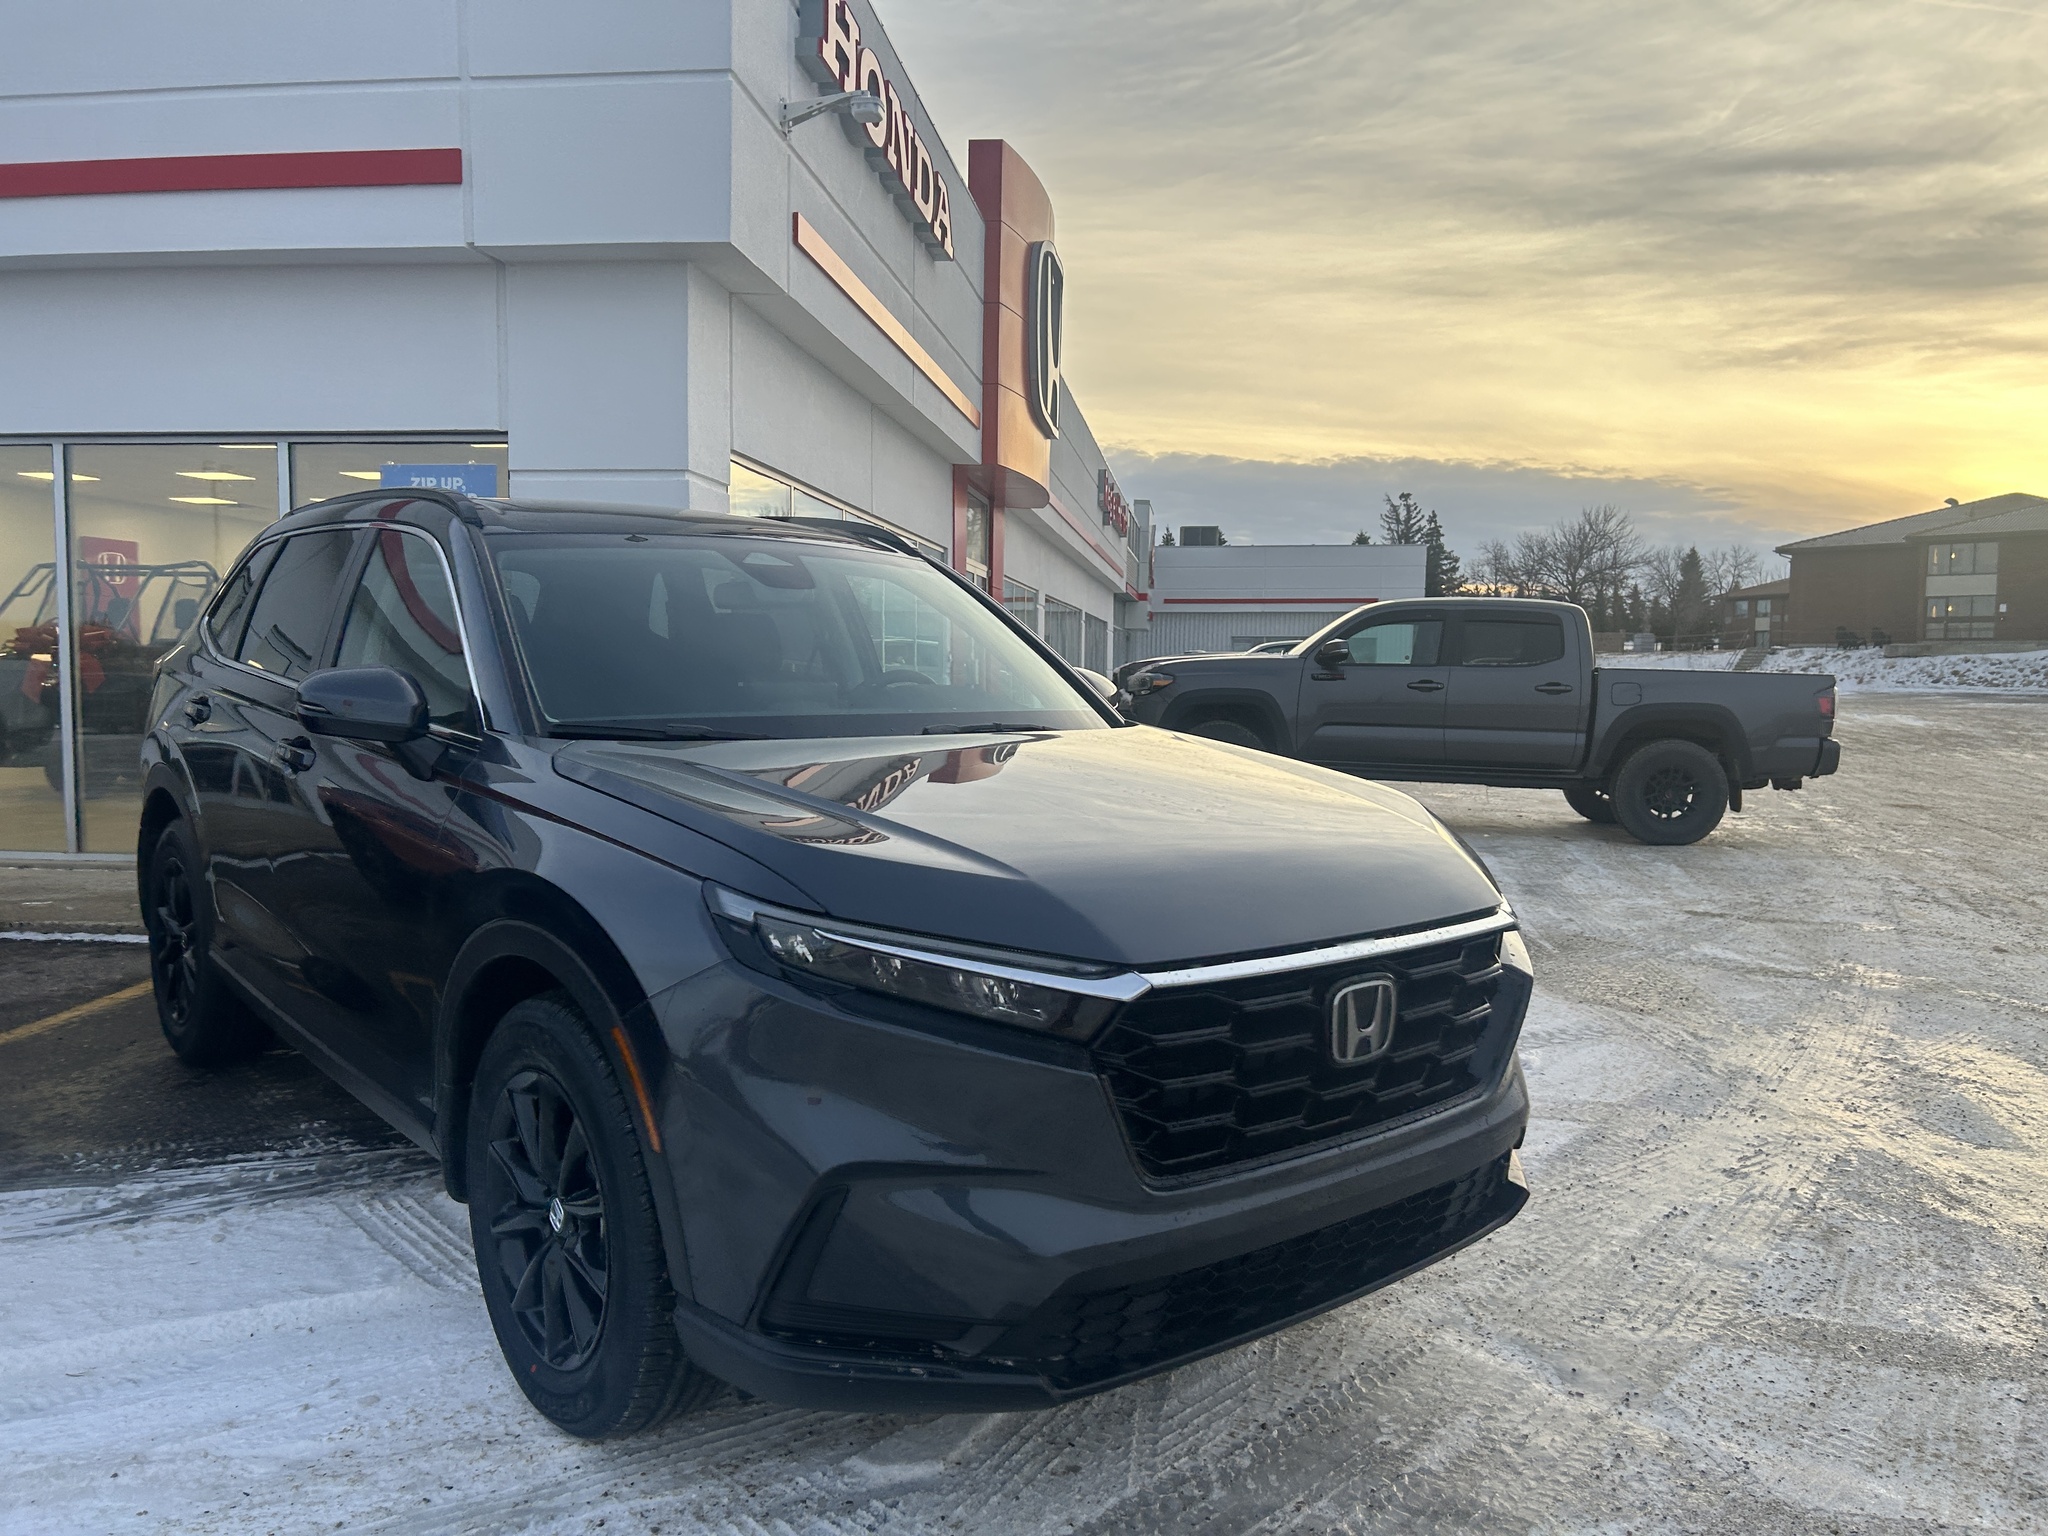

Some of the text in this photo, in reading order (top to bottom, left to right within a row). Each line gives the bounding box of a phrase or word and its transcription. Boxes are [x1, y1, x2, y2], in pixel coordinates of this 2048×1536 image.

[821, 0, 954, 262] HONDA
[410, 477, 467, 492] ZIP UP,
